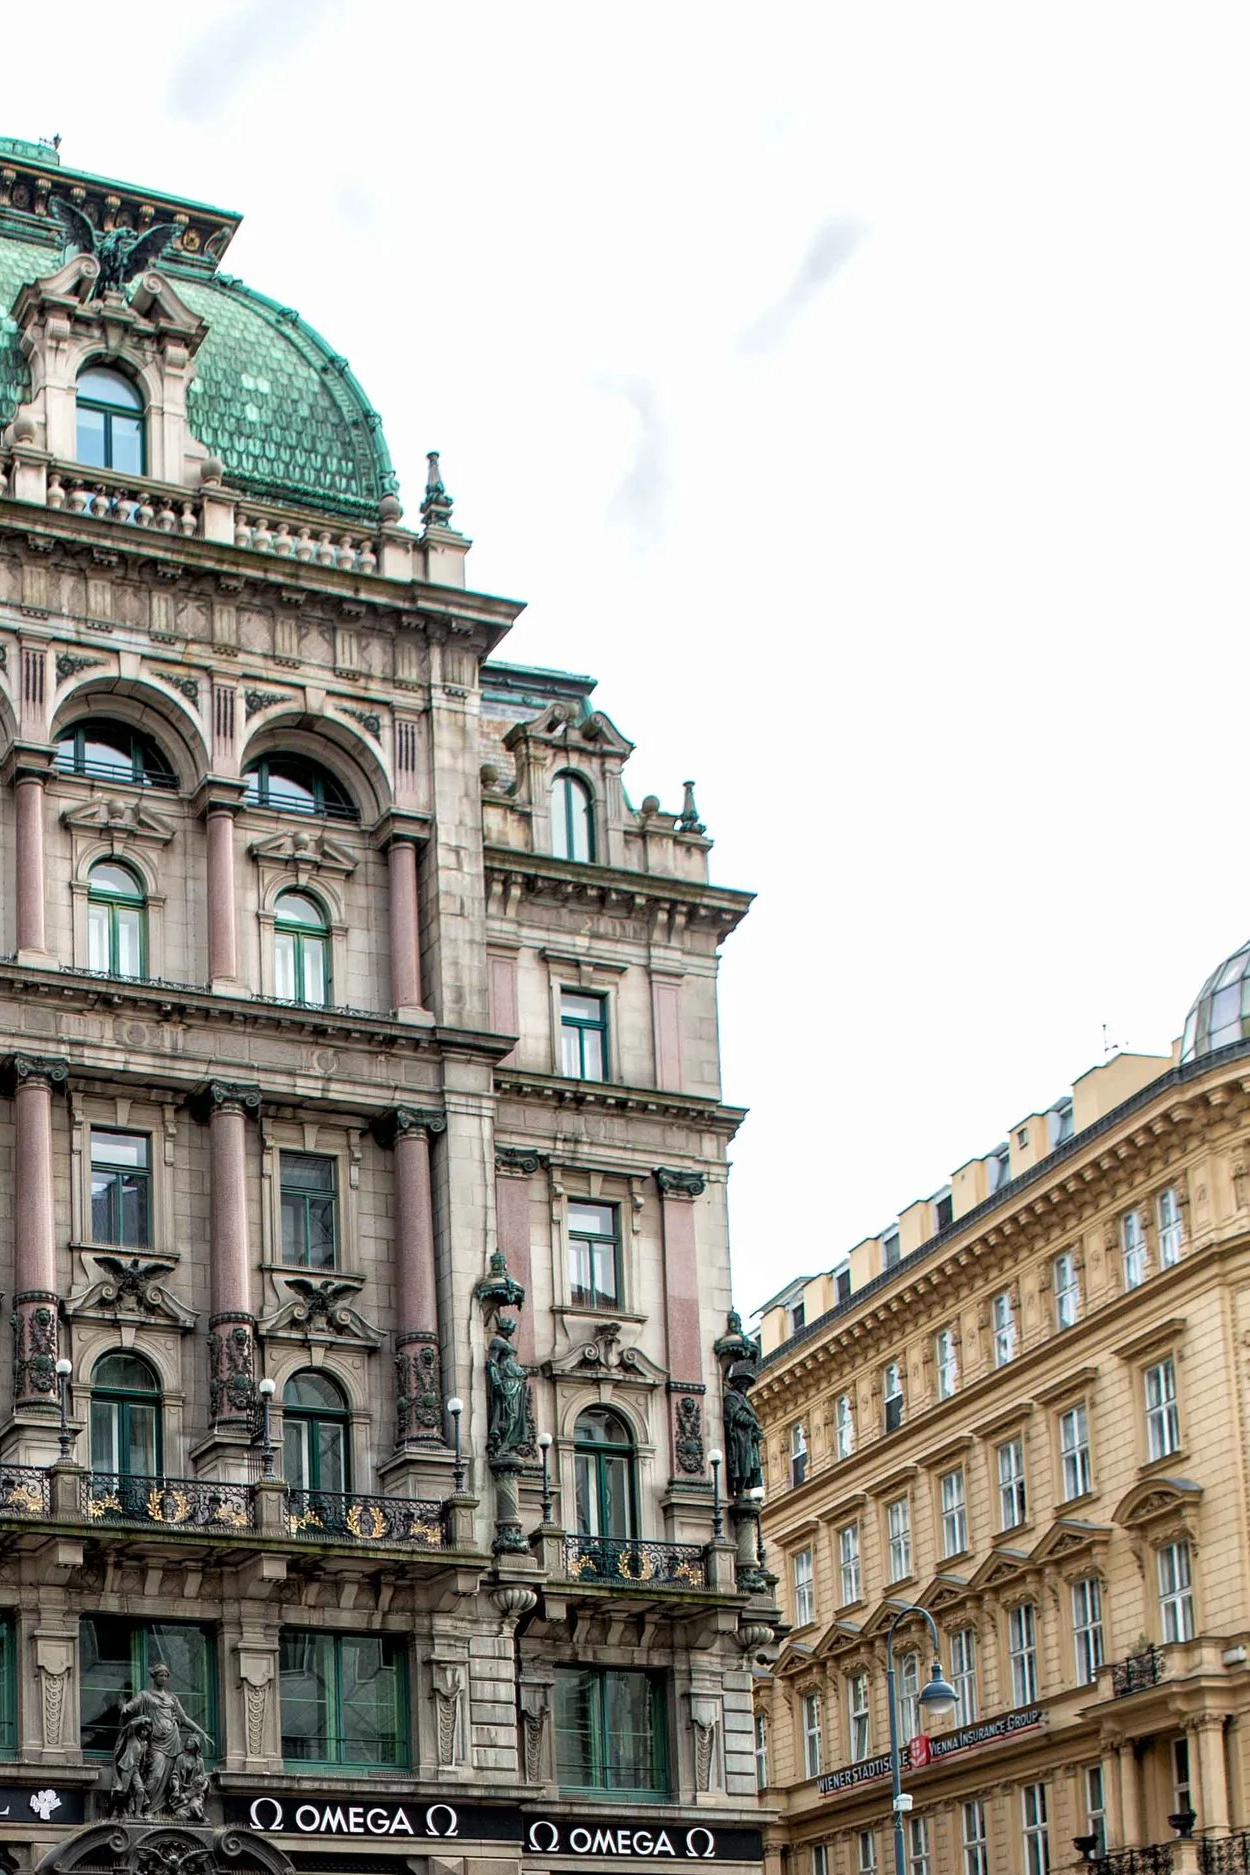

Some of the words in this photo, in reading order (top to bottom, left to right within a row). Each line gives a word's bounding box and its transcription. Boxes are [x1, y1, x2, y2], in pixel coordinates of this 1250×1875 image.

[1006, 1710, 1038, 1732] GROUP
[816, 1770, 851, 1793] WIENER
[295, 1804, 415, 1835] OMEGA
[569, 1827, 676, 1857] OMEGA
